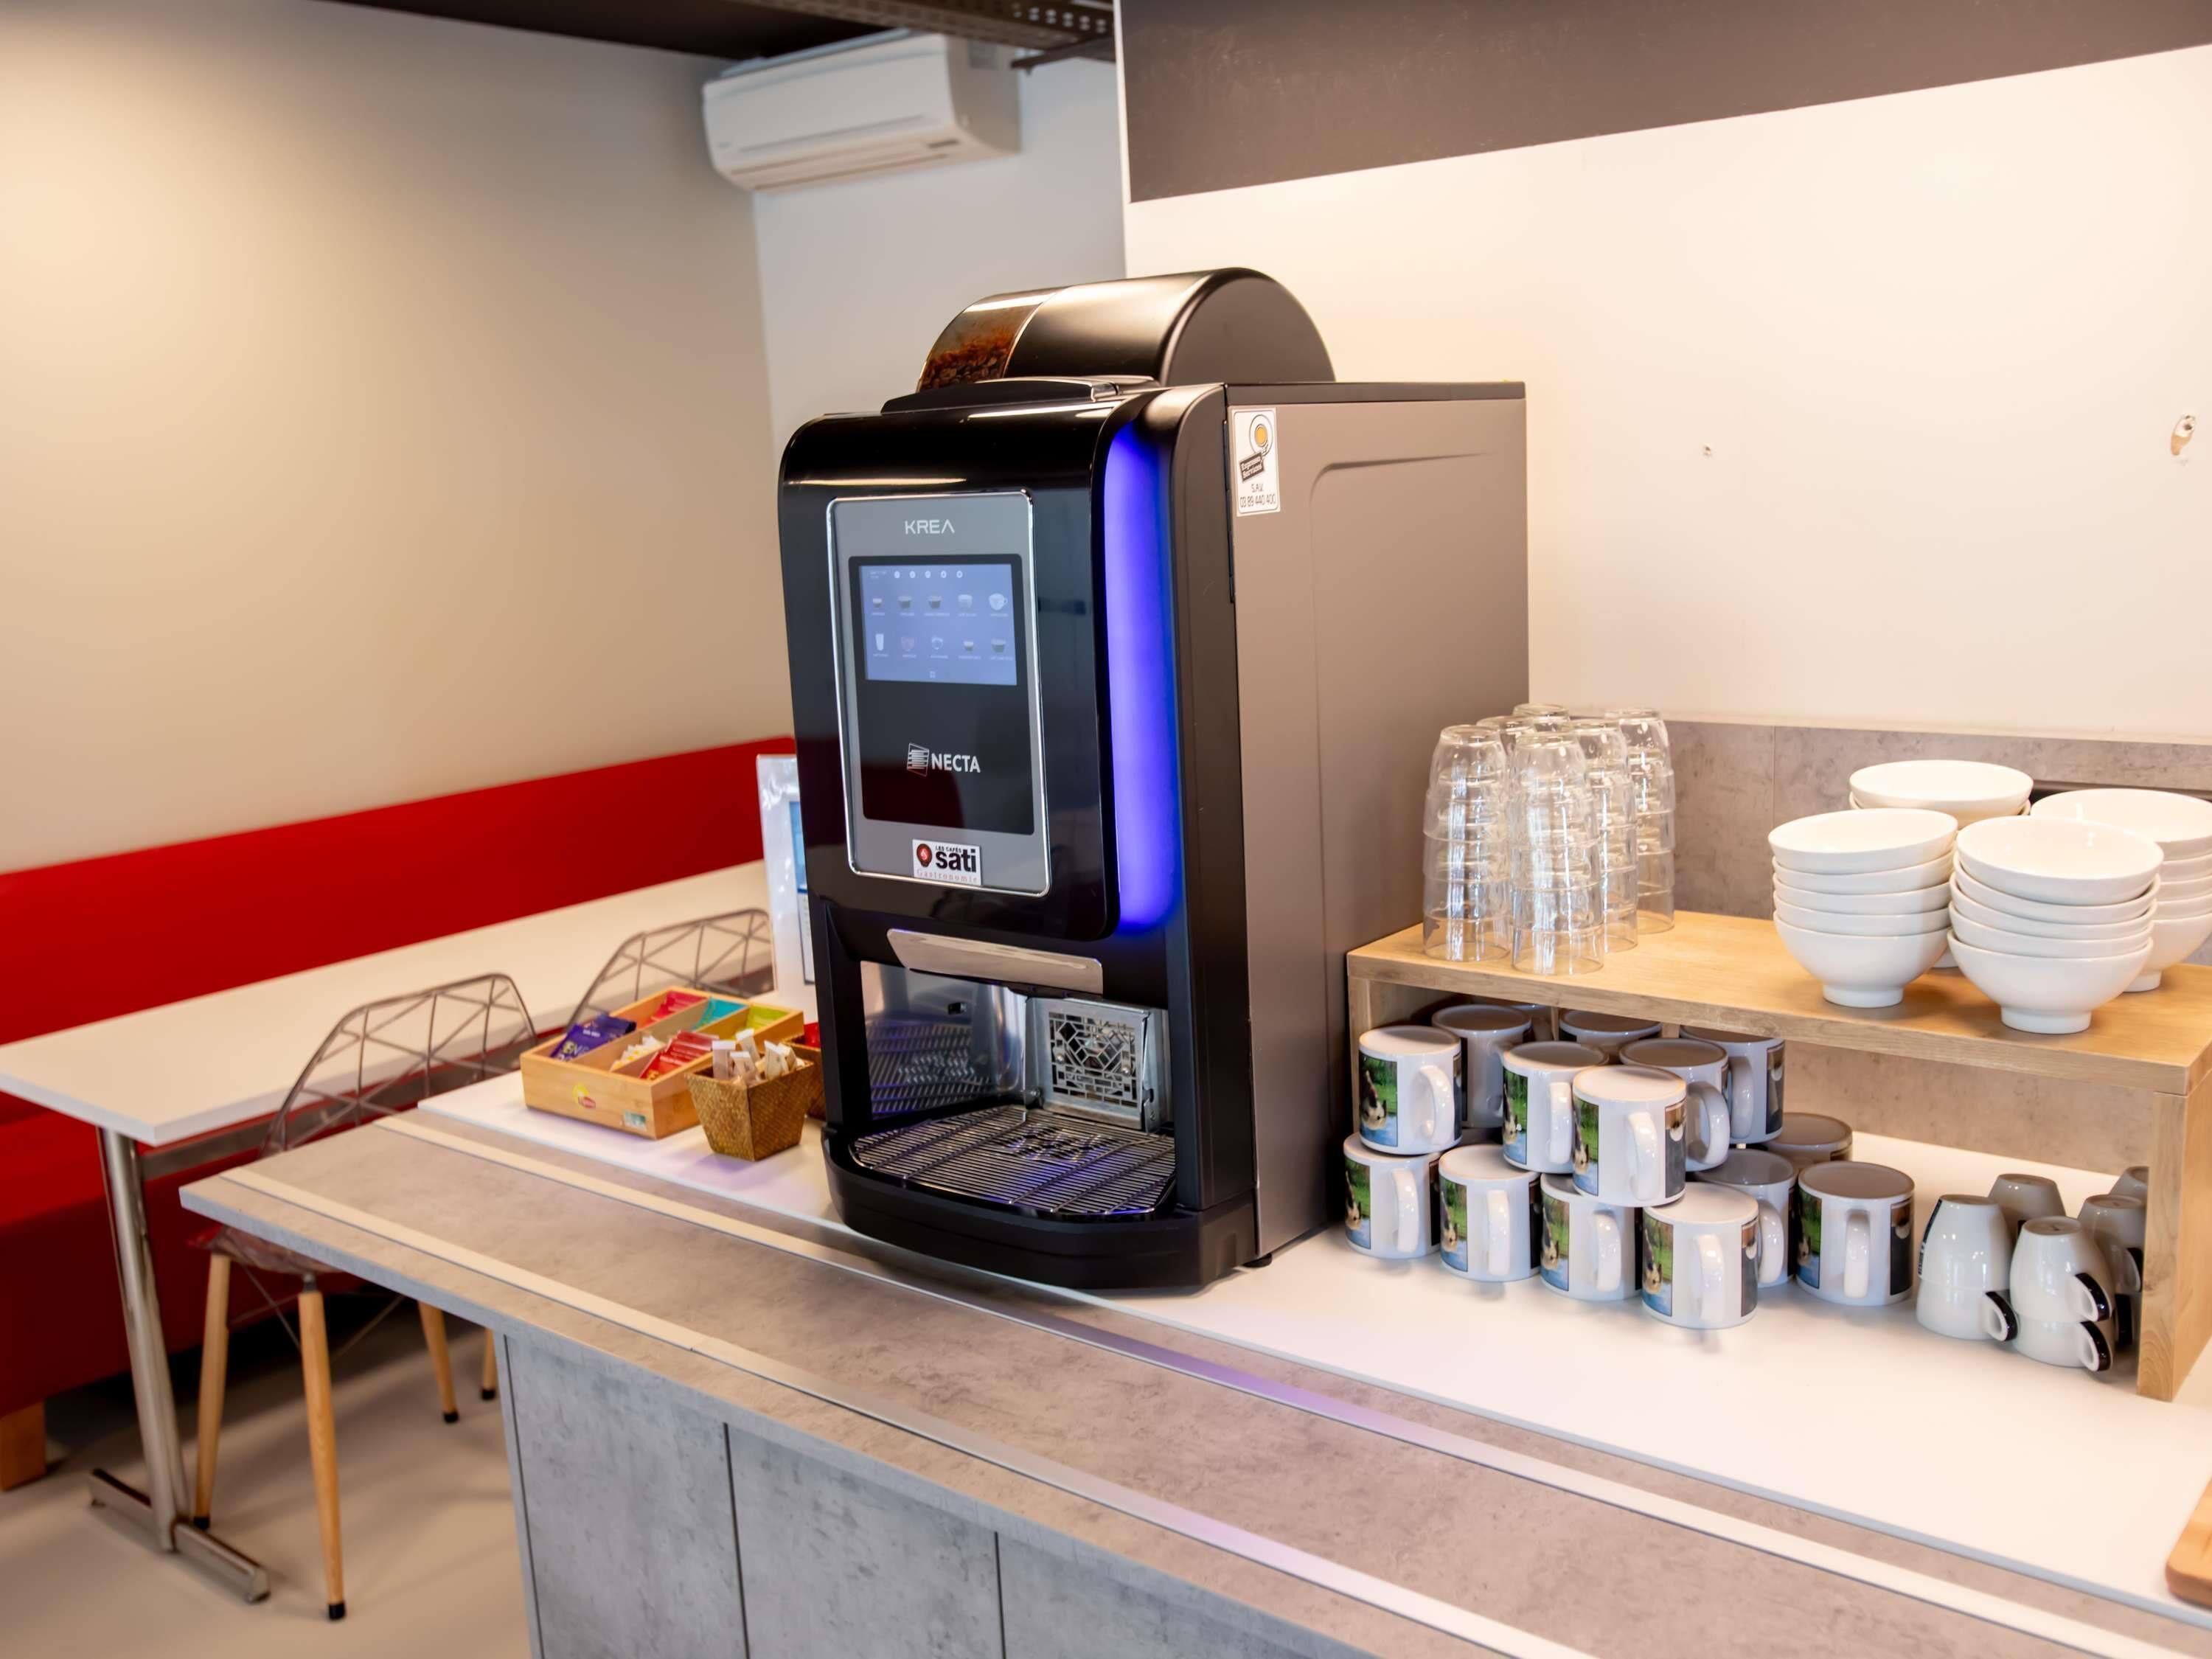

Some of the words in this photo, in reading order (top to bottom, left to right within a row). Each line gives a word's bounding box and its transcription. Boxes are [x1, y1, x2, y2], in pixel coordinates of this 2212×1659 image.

[1240, 496, 1247, 507] 03
[1248, 495, 1254, 507] 89
[905, 519, 955, 535] KREA
[931, 753, 981, 773] NECTA
[935, 849, 977, 873] sati
